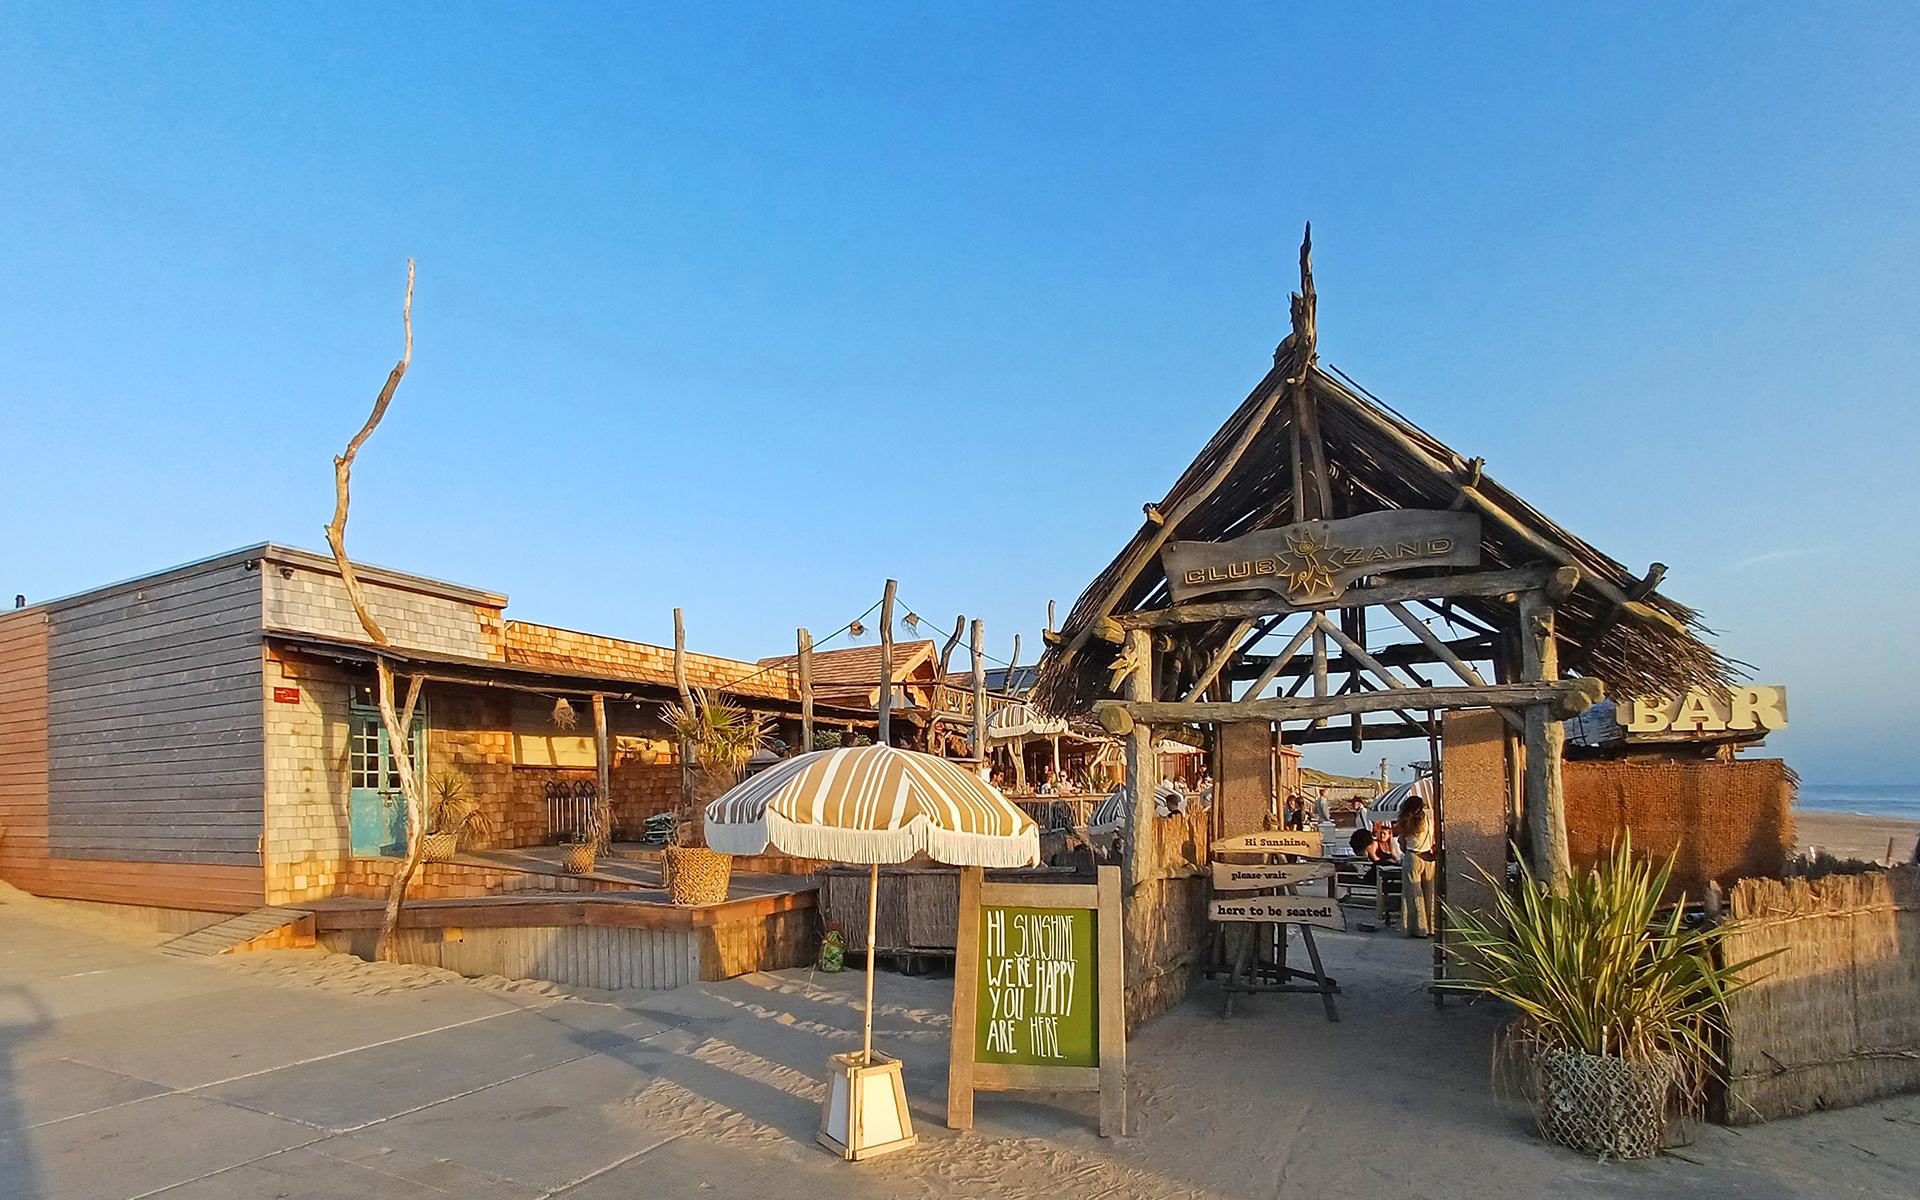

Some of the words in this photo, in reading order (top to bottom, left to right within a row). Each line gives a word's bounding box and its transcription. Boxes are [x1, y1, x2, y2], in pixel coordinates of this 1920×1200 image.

[1184, 558, 1277, 585] CLUB
[1343, 537, 1455, 565] ZAND
[1627, 685, 1789, 733] BAR
[1244, 838, 1257, 847] Hi
[1231, 870, 1262, 881] please
[1263, 870, 1287, 880] wait
[1217, 905, 1246, 916] here
[1249, 906, 1264, 916] to
[1268, 906, 1282, 917] be
[1286, 907, 1332, 918] seated!
[987, 909, 1006, 957] HI
[986, 957, 1034, 988] WE'RE
[1035, 959, 1076, 1017] HAPPY
[988, 987, 1025, 1021] YOU
[986, 1019, 1018, 1054] ARE
